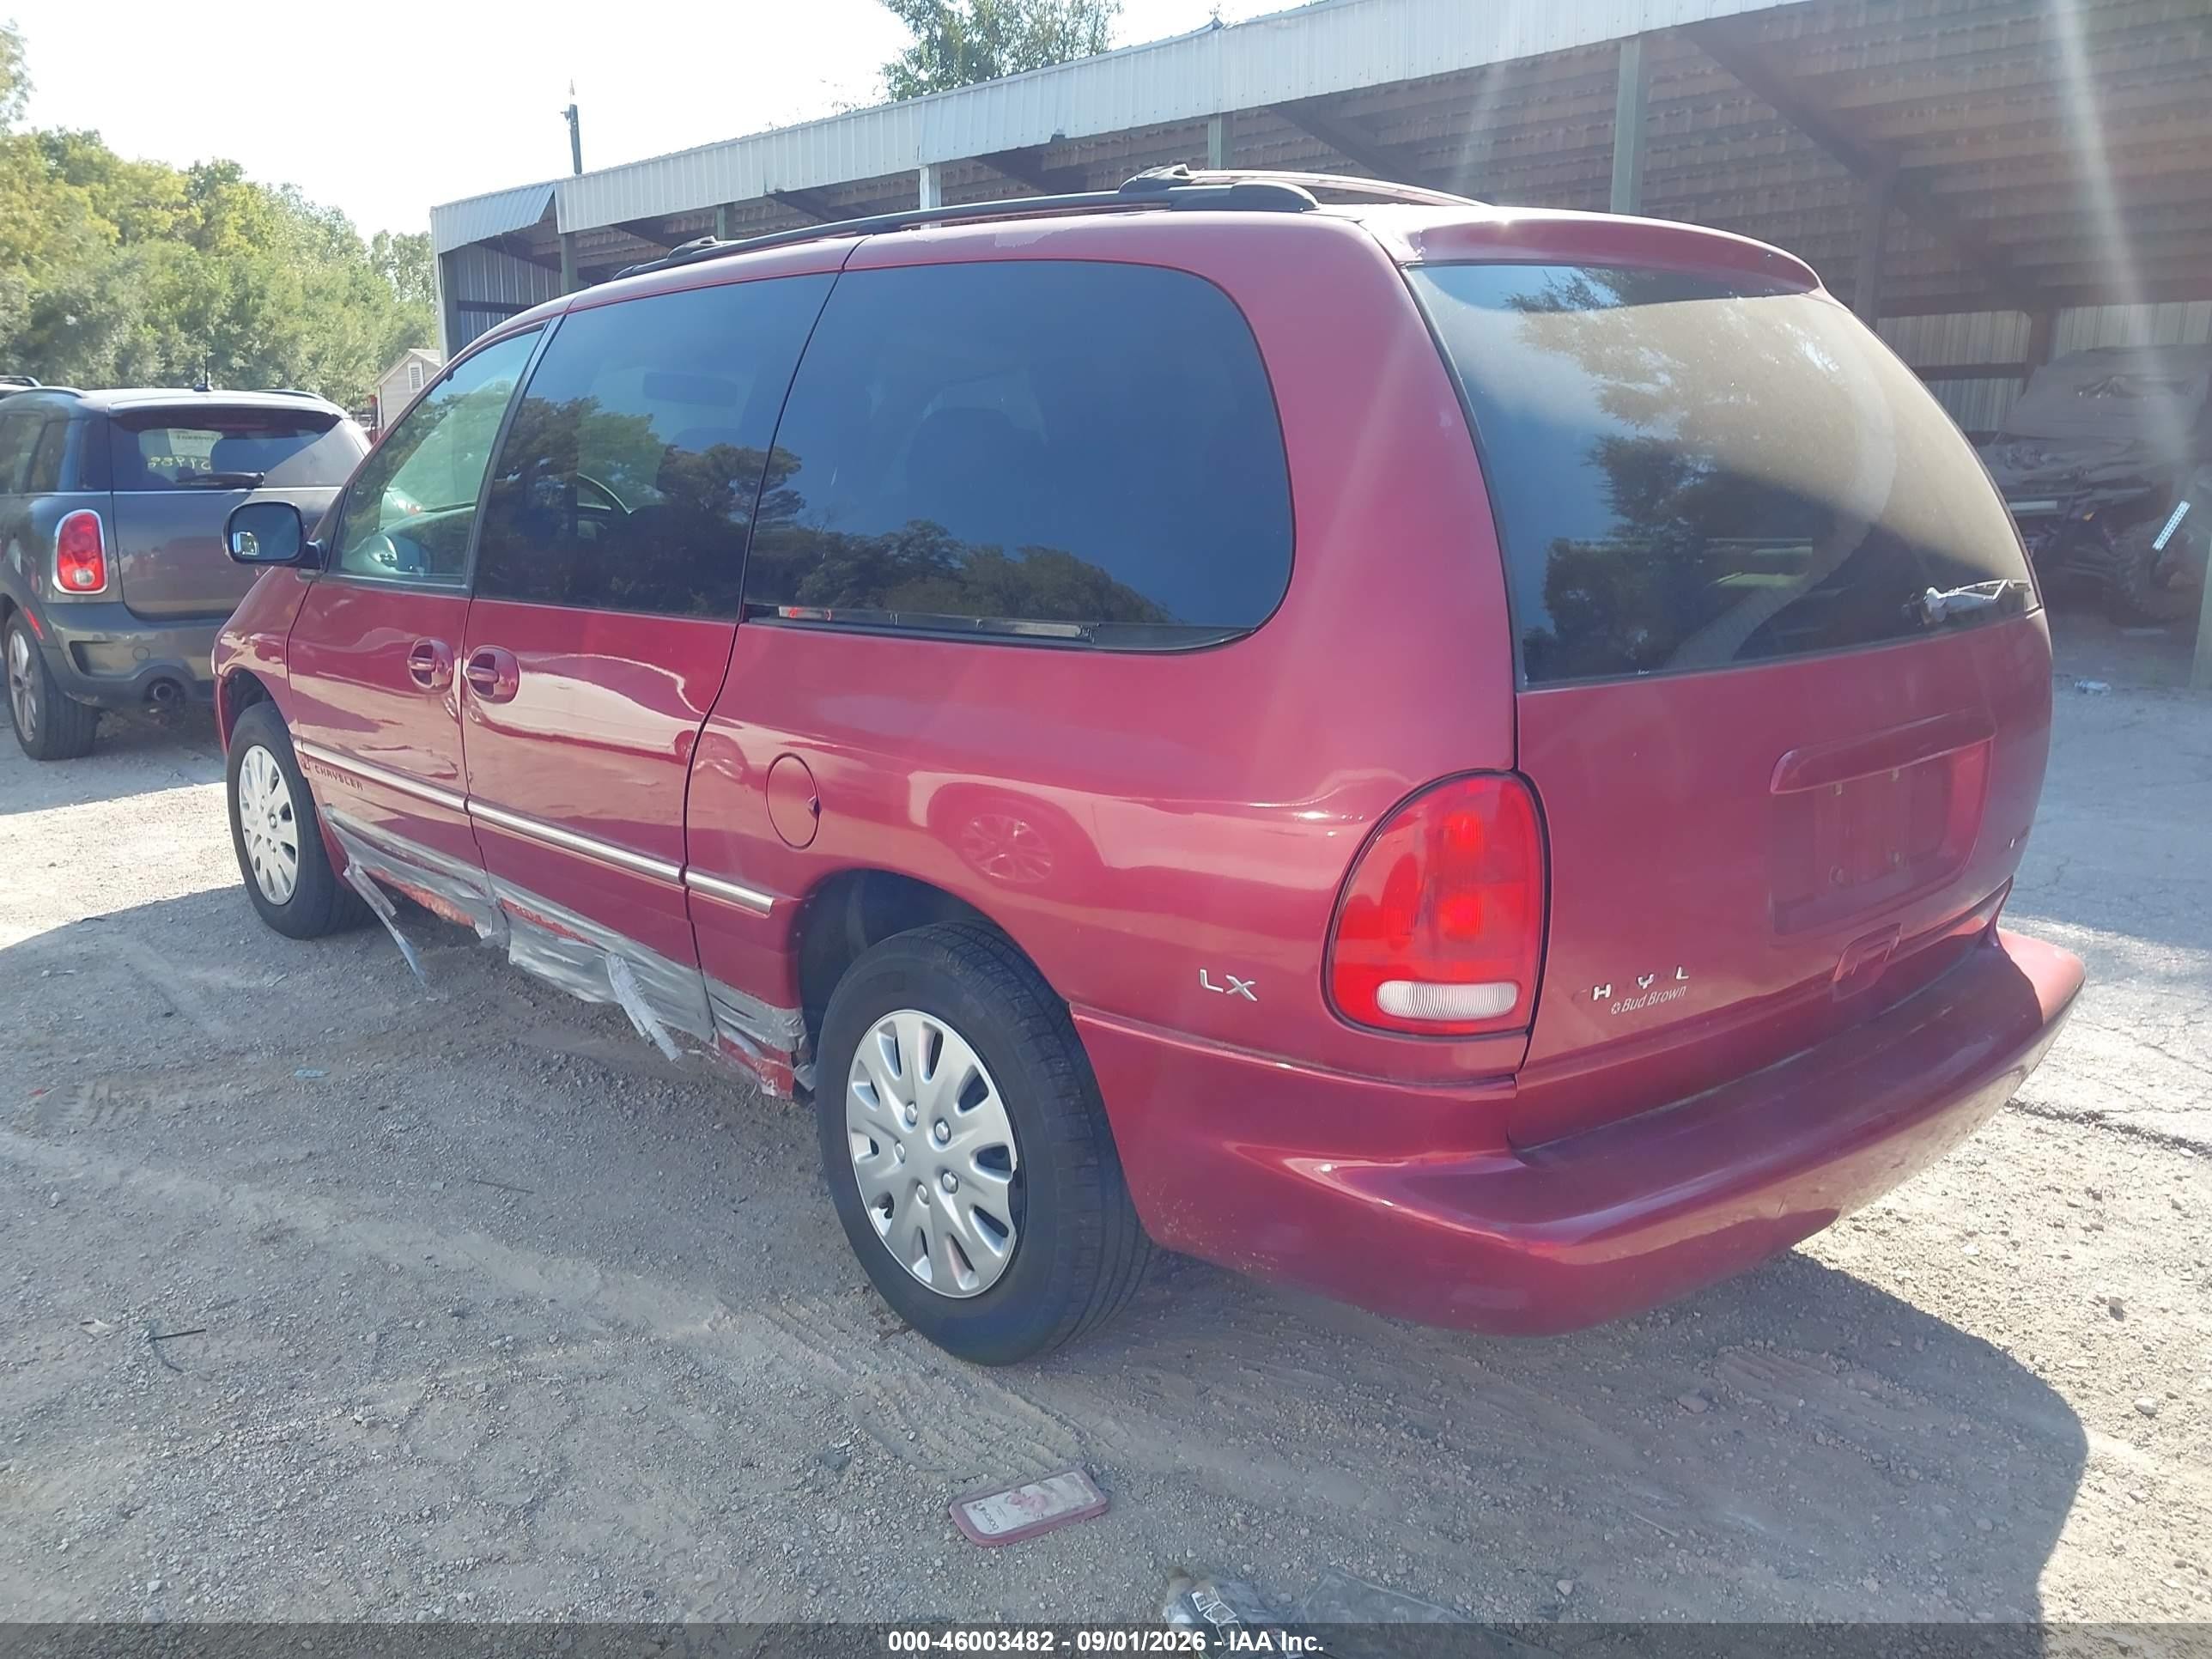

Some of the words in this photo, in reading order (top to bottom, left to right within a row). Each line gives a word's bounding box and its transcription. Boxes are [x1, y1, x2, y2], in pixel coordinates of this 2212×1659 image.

[314, 763, 365, 791] CHRYSLER
[1200, 969, 1258, 1002] LX
[1620, 994, 1648, 1013] Bud
[1647, 985, 1687, 1006] Brown
